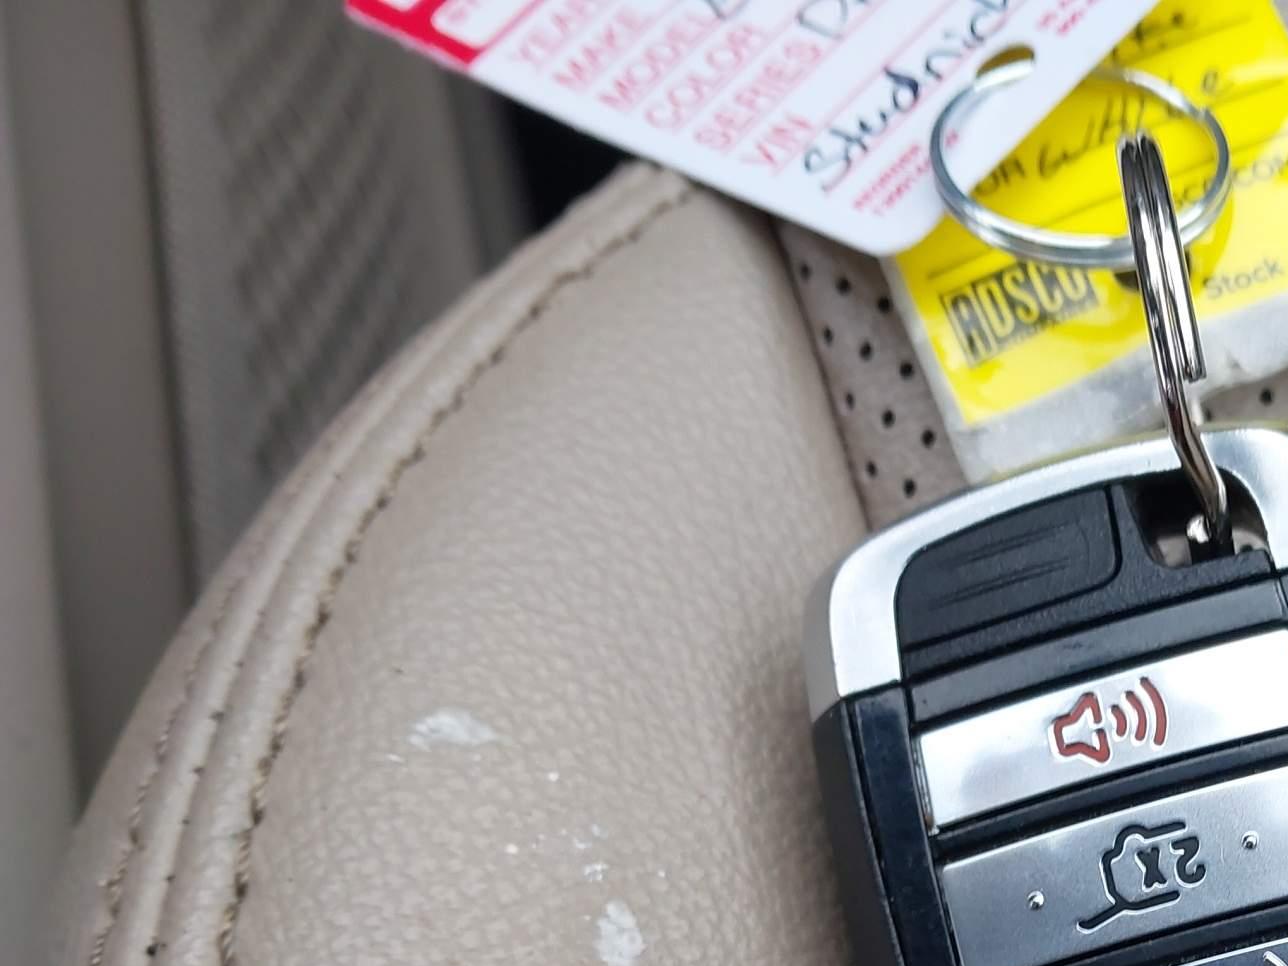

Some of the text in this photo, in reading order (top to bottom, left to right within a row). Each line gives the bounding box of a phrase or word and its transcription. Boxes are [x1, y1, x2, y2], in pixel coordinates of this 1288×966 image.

[552, 6, 648, 90] MAKE
[600, 13, 720, 112] MODEL
[644, 26, 767, 135] COLOR
[692, 40, 823, 151] SERIES
[741, 111, 814, 174] VIN
[1202, 257, 1285, 300] Stock
